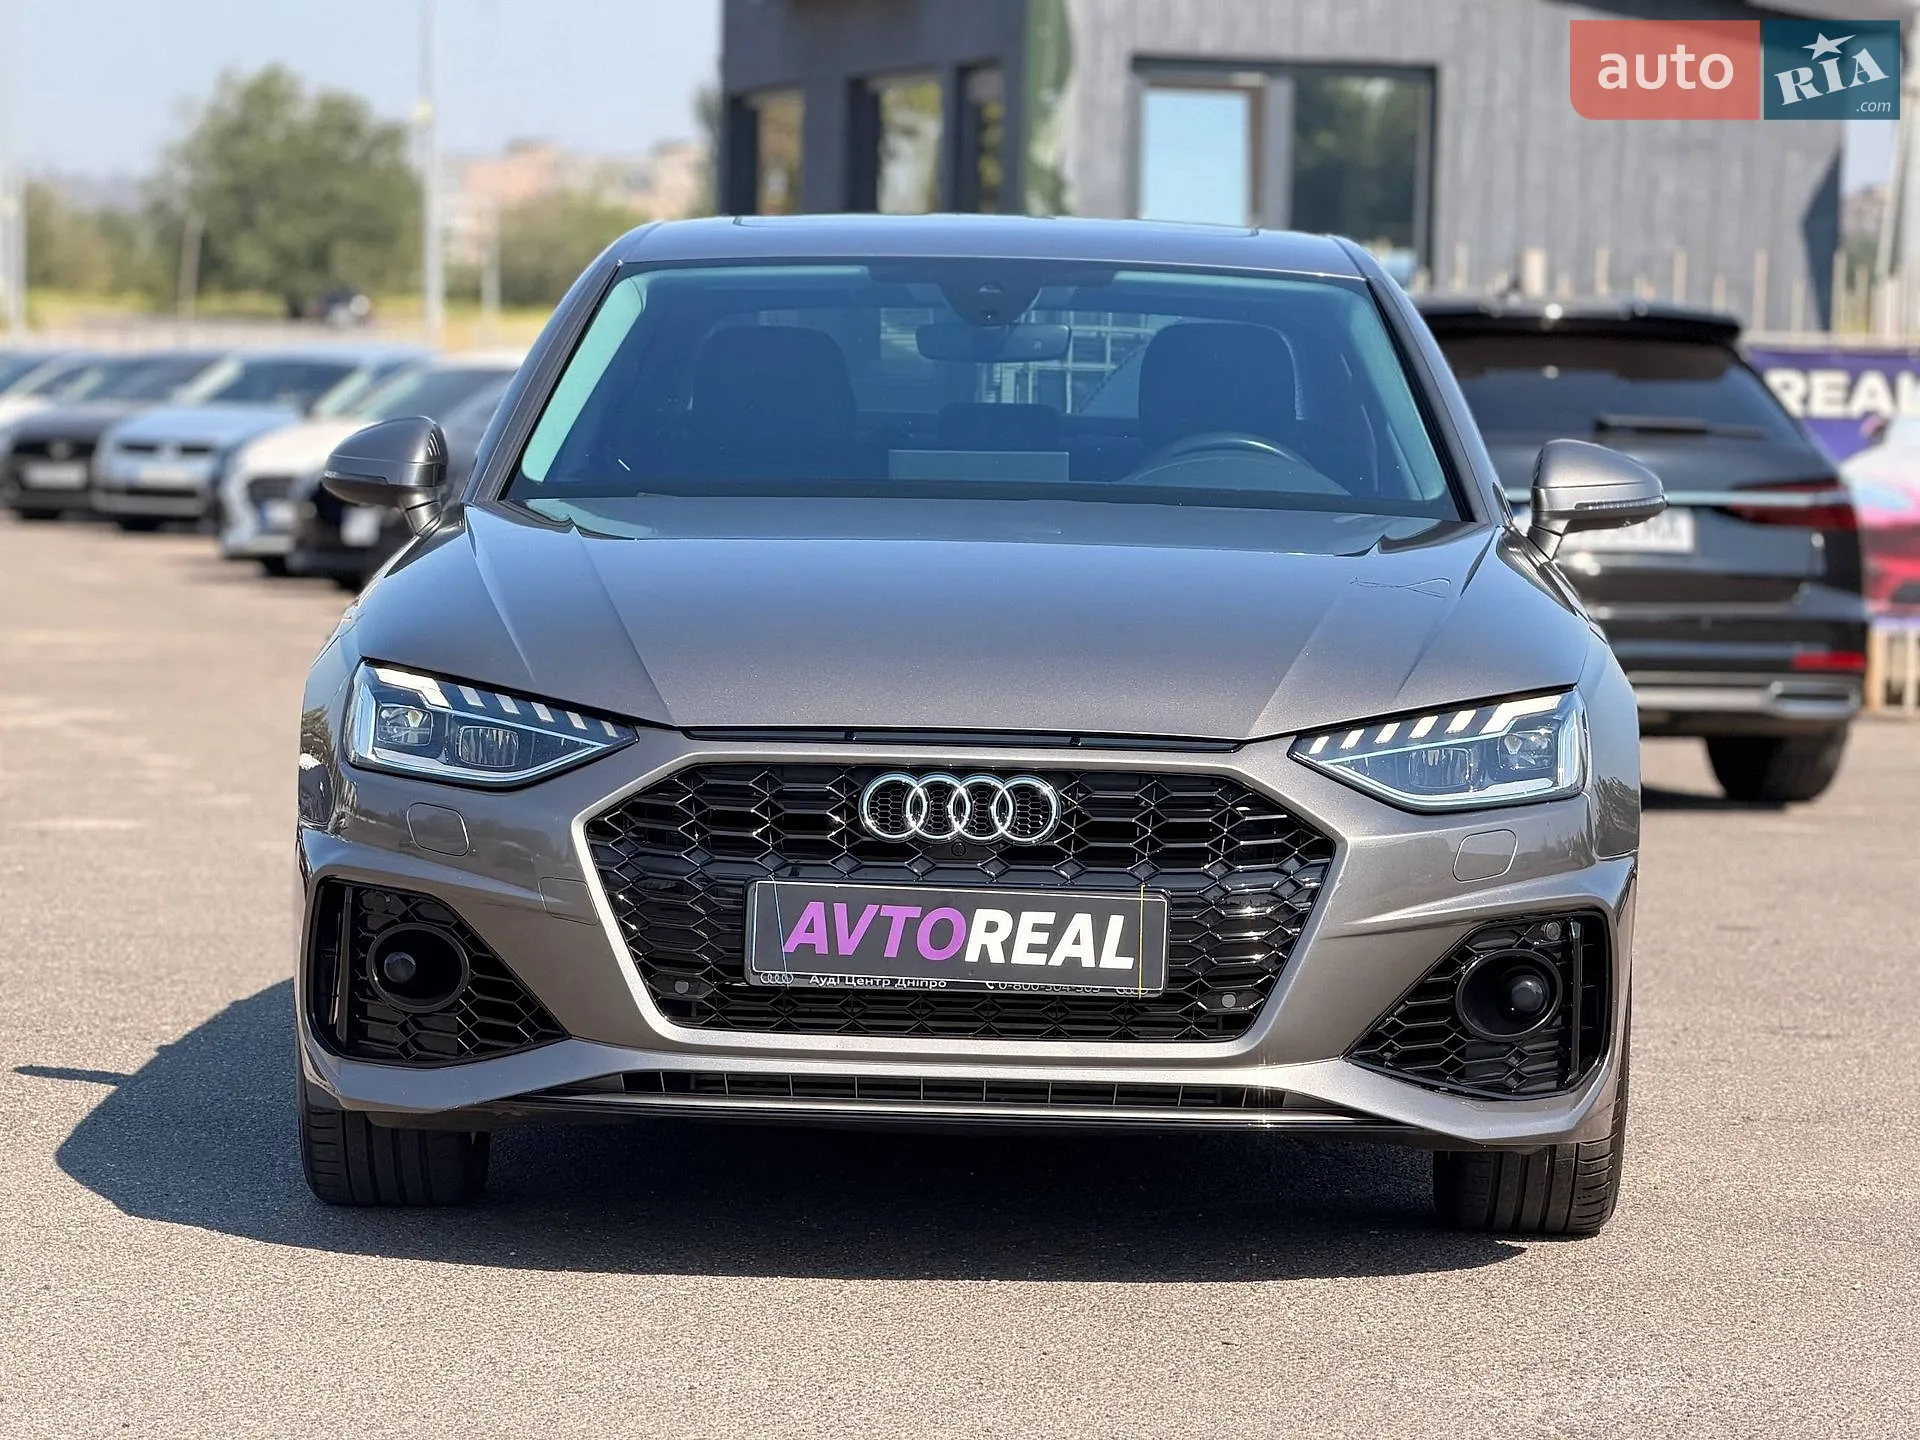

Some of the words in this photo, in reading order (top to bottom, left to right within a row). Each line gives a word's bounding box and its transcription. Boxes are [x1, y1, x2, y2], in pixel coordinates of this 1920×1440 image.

[783, 901, 1134, 970] AVTOREAL
[809, 975, 840, 987] Ауді
[845, 976, 891, 988] Центр
[895, 978, 947, 989] Дніпро
